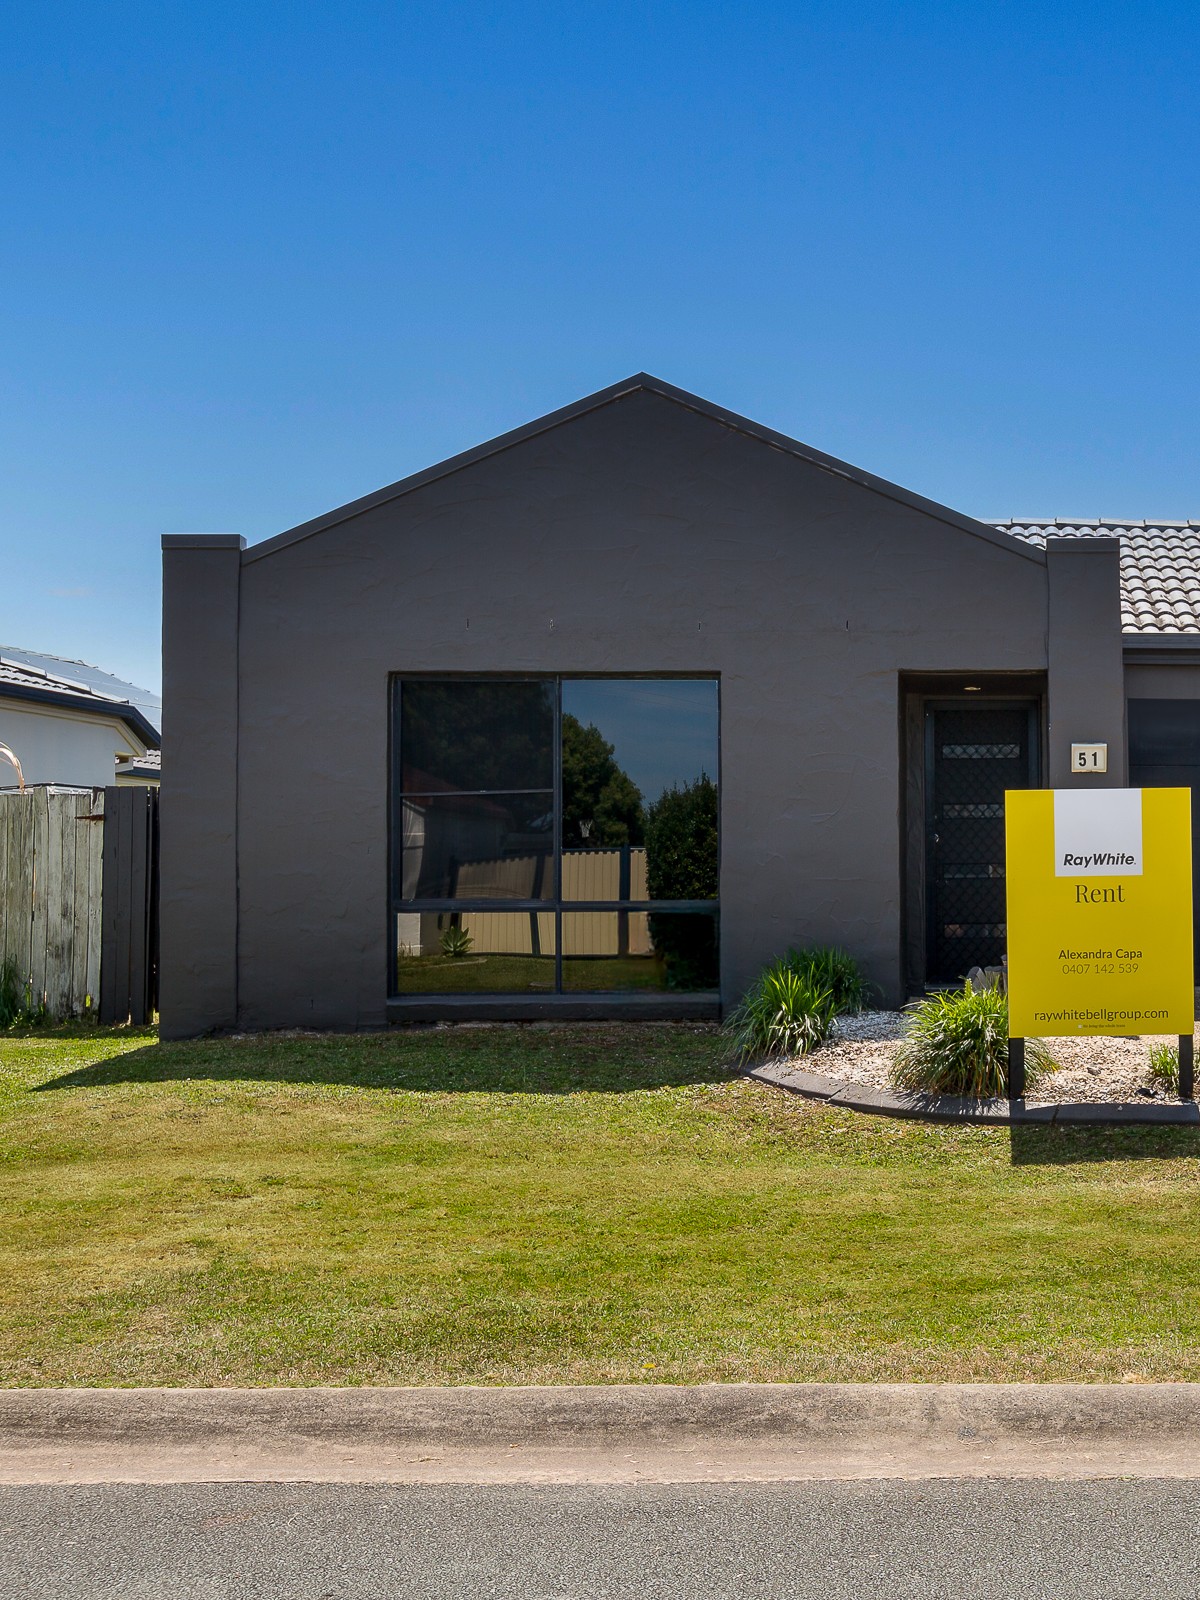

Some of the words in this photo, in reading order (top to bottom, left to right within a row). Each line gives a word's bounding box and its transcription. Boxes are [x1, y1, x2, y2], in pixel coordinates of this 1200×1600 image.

[1078, 751, 1097, 767] 51
[1075, 884, 1126, 904] Rent
[1058, 949, 1113, 960] Alexandra
[1115, 948, 1143, 960] Capa
[1062, 964, 1091, 975] 0407
[1094, 963, 1115, 974] 142
[1118, 963, 1139, 974] 539
[1034, 1008, 1169, 1023] raywhitebellgroup.com
